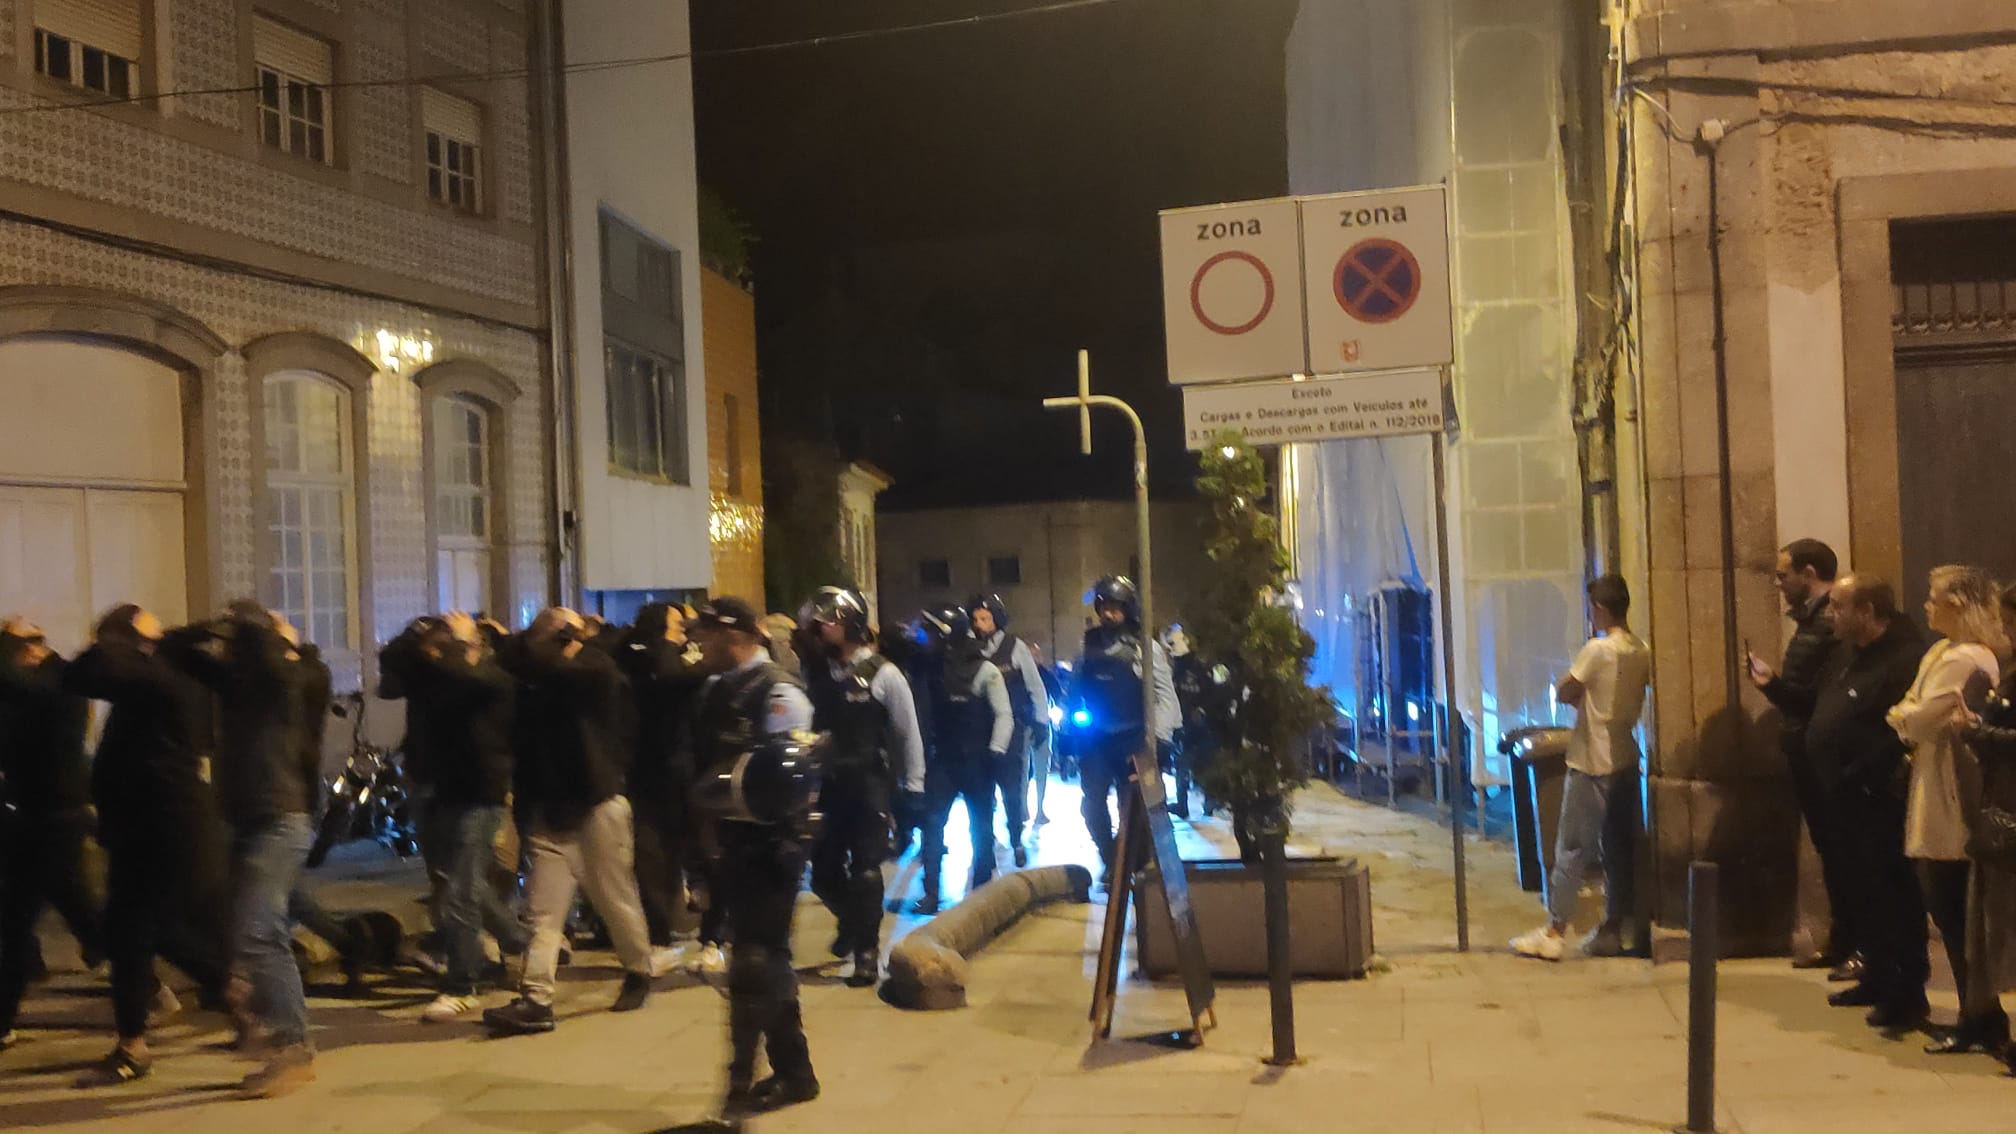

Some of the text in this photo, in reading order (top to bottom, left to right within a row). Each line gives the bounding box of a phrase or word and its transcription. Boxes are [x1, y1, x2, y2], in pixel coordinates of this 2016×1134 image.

[1340, 206, 1408, 227] zona
[1197, 219, 1262, 240] zona
[1291, 387, 1332, 399] Exceto
[1200, 411, 1241, 422] Cargas
[1245, 411, 1253, 419] e
[1258, 406, 1318, 419] Descargas
[1323, 404, 1348, 414] com
[1241, 426, 1281, 437] Acordo
[1288, 424, 1312, 433] com
[1317, 424, 1324, 432] o
[1329, 420, 1364, 432] Edital
[1386, 414, 1440, 428] 112/2018
